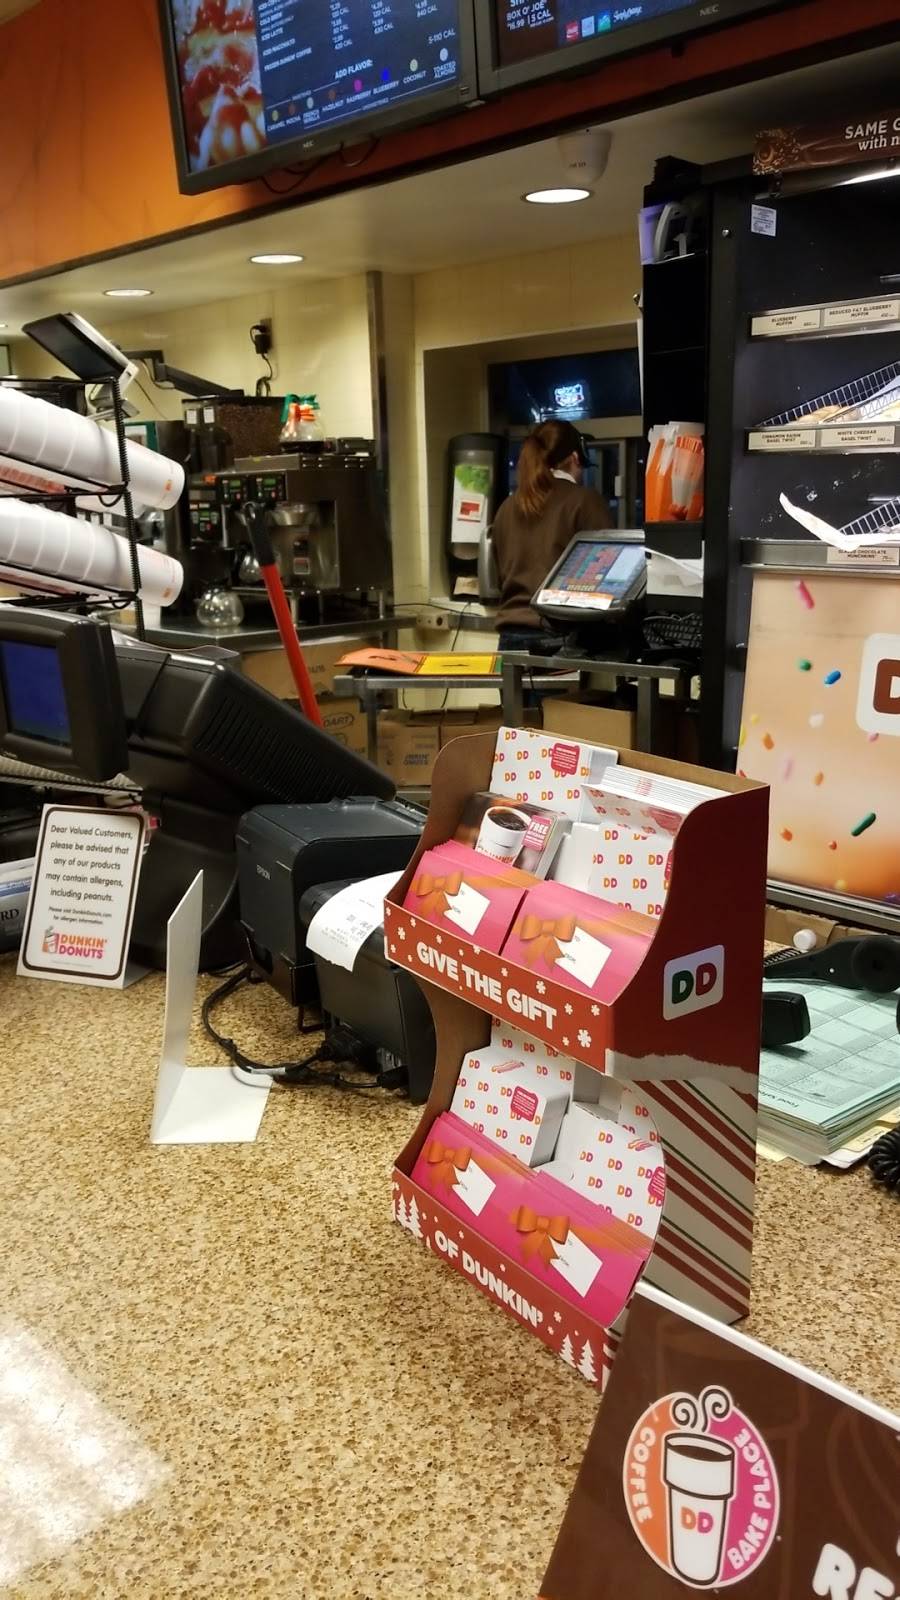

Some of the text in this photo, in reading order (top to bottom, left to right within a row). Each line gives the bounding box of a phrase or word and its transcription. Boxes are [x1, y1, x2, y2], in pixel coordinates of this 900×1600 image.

[426, 4, 438, 14] CAL
[506, 9, 521, 21] BOX
[530, 2, 546, 13] JOE
[537, 9, 552, 20] CAL
[700, 4, 720, 17] NEC
[442, 28, 456, 39] CAL
[335, 68, 348, 80] ADD
[402, 70, 427, 84] COCONUT
[373, 80, 400, 95] BLUEBERRY
[346, 90, 372, 105] RASPBERRY
[845, 119, 889, 140] SAME
[857, 134, 887, 151] with
[829, 304, 892, 316] REDUCED FAT BLUEBERRY
[771, 315, 798, 324] BLUEBERRY
[505, 731, 518, 741] DD
[517, 750, 529, 761] DD
[505, 772, 517, 782] DD
[529, 770, 542, 780] DD
[517, 792, 529, 802] DD
[541, 791, 554, 801] DD
[568, 789, 580, 799] DD
[50, 824, 134, 841] Dear Valued Customers,
[529, 821, 549, 835] FREE
[605, 830, 619, 841] DD
[50, 840, 130, 855] please be advised that
[53, 857, 122, 871] any of our products
[618, 854, 633, 865] DD
[648, 854, 664, 866] DD
[45, 872, 61, 884] may
[62, 874, 89, 884] contain
[89, 875, 125, 889] allergens,
[604, 878, 618, 888] DD
[632, 878, 648, 890] DD
[50, 887, 83, 902] including
[647, 904, 662, 915] DD
[60, 934, 108, 949] DUNKIN'
[59, 944, 104, 960] DONUTS
[416, 941, 557, 1031] GIVE THE GIFT
[671, 962, 718, 1005] DD
[502, 1039, 513, 1049] DD
[524, 1042, 536, 1053] DD
[469, 1059, 481, 1069] DD
[536, 1065, 549, 1076] DD
[560, 1070, 573, 1081] DD
[478, 1081, 489, 1092] DD
[500, 1087, 513, 1097] DD
[464, 1099, 476, 1110] DD
[487, 1104, 499, 1115] DD
[635, 1105, 650, 1117] DD
[496, 1128, 508, 1139] DD
[598, 1132, 613, 1144] DD
[519, 1134, 532, 1146] DD
[580, 1151, 594, 1163] DD
[607, 1158, 623, 1171] DD
[637, 1167, 653, 1179] DD
[588, 1176, 603, 1189] DD
[617, 1185, 633, 1198] DD
[627, 1213, 643, 1227] DD
[434, 1230, 544, 1329] OF DUNKIN'
[631, 1426, 656, 1523] COFFEE
[727, 1428, 772, 1571] BAKE PLACE
[680, 1506, 715, 1535] DD
